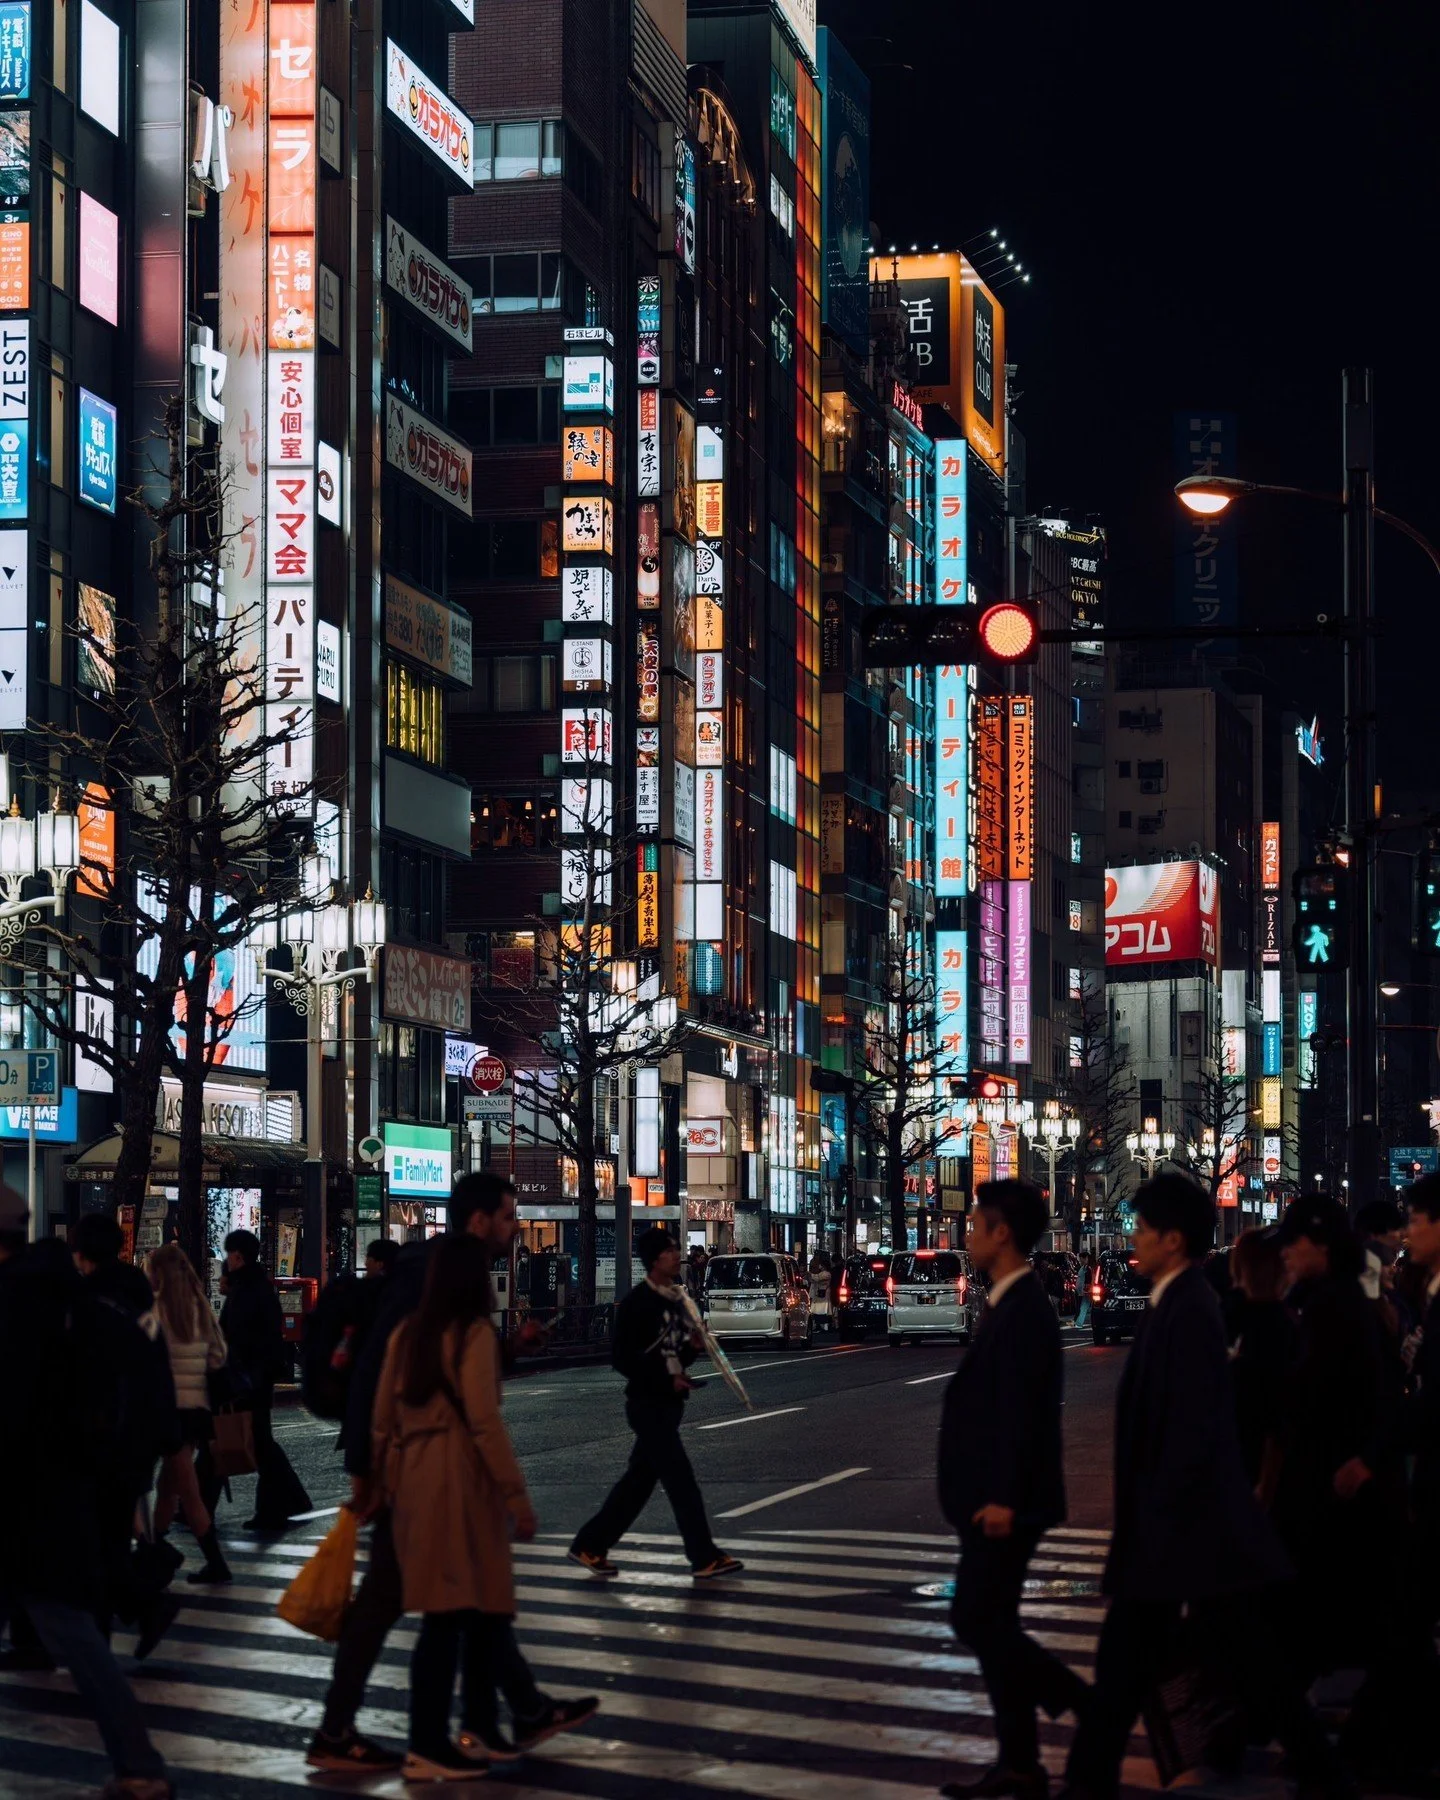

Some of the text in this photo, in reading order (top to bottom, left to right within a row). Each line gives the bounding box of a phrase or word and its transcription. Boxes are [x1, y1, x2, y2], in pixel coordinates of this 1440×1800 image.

[271, 39, 313, 170] セラ
[417, 86, 462, 160] カラオケ
[294, 250, 312, 292] 名物
[416, 258, 462, 328] カラオケ
[566, 329, 602, 339] 石塚ビル
[900, 298, 934, 334] 活
[974, 309, 991, 364] 快活
[3, 331, 27, 406] ZEST
[974, 361, 991, 401] CLUB
[280, 361, 303, 459] 安心個室
[893, 381, 924, 431] カラオケ館
[415, 427, 461, 494] カラオケ
[567, 431, 601, 467] 縁の宴
[640, 432, 657, 472] 吉宗
[274, 479, 308, 576] ママ会
[566, 503, 600, 540] かまどか
[706, 485, 720, 532] 千里香
[709, 541, 721, 549] 6F
[941, 456, 962, 600] カラオケ
[570, 569, 594, 620] 炉とマタギ
[698, 574, 716, 582] Darts
[702, 583, 721, 593] UP
[1071, 589, 1099, 605] OKYO.
[704, 601, 714, 648] 駄菓子バー
[273, 598, 306, 768] パーティー
[576, 681, 589, 691] 5F
[702, 655, 715, 704] カラオケ
[639, 770, 650, 806] ます屋
[1014, 722, 1025, 869] コミック・インターネット
[637, 824, 659, 834] 4F
[703, 780, 714, 877] カラオケ まねきねこ
[1265, 839, 1277, 875] ガスト
[568, 858, 589, 897] ねぎし
[1105, 920, 1171, 956] アコム
[1267, 903, 1275, 948] RIZAP
[1013, 936, 1027, 981] コスモス
[1014, 987, 1025, 999] 薬
[1014, 1003, 1025, 1034] 化粧品
[1304, 1004, 1314, 1038] NOVA
[0, 1059, 19, 1085] 0分
[30, 1081, 53, 1092] 7-20
[35, 1056, 49, 1079] P
[475, 1067, 502, 1080] 消火栓
[467, 1099, 509, 1107] SUBNADE
[687, 1127, 717, 1147] ねこ
[405, 1157, 443, 1185] FamilyMart
